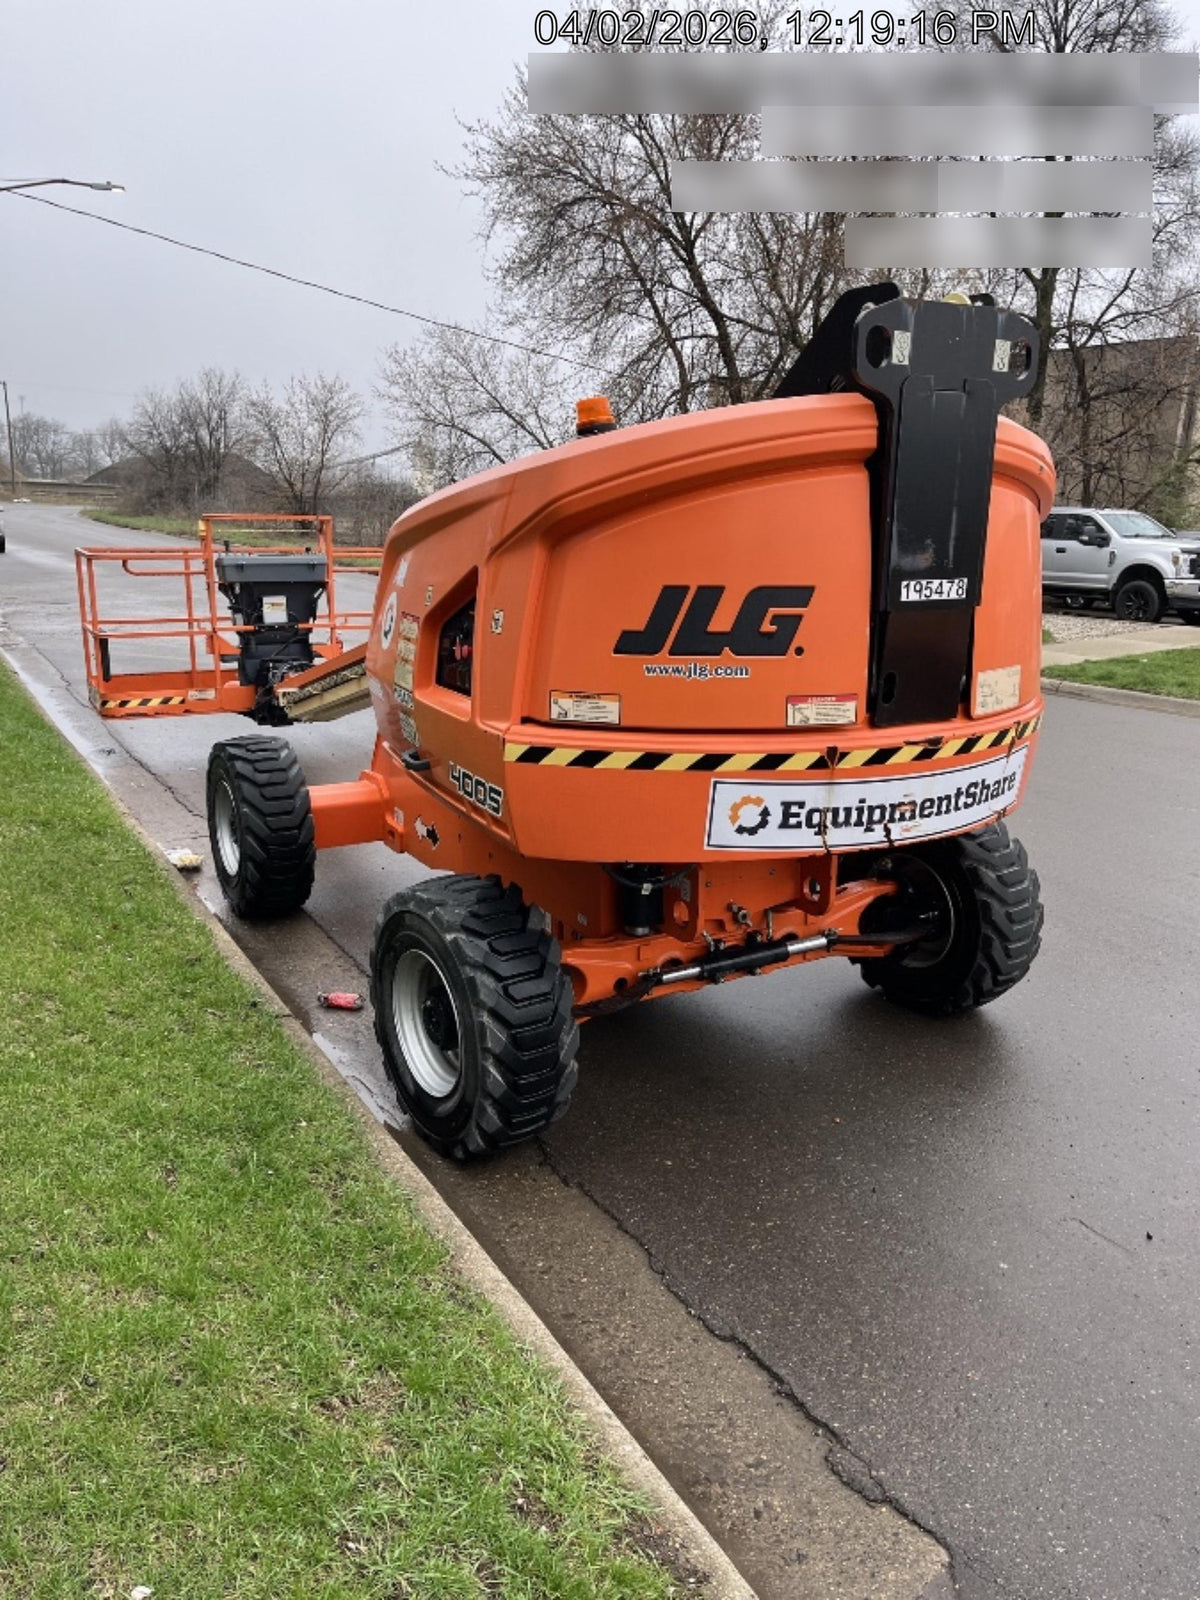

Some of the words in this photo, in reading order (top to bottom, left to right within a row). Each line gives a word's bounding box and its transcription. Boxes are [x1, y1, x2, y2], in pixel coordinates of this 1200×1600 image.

[902, 578, 966, 600] 195478
[643, 662, 750, 680] www.jlg.com
[449, 761, 503, 817] 400S
[778, 769, 1017, 836] EquipmentShare
